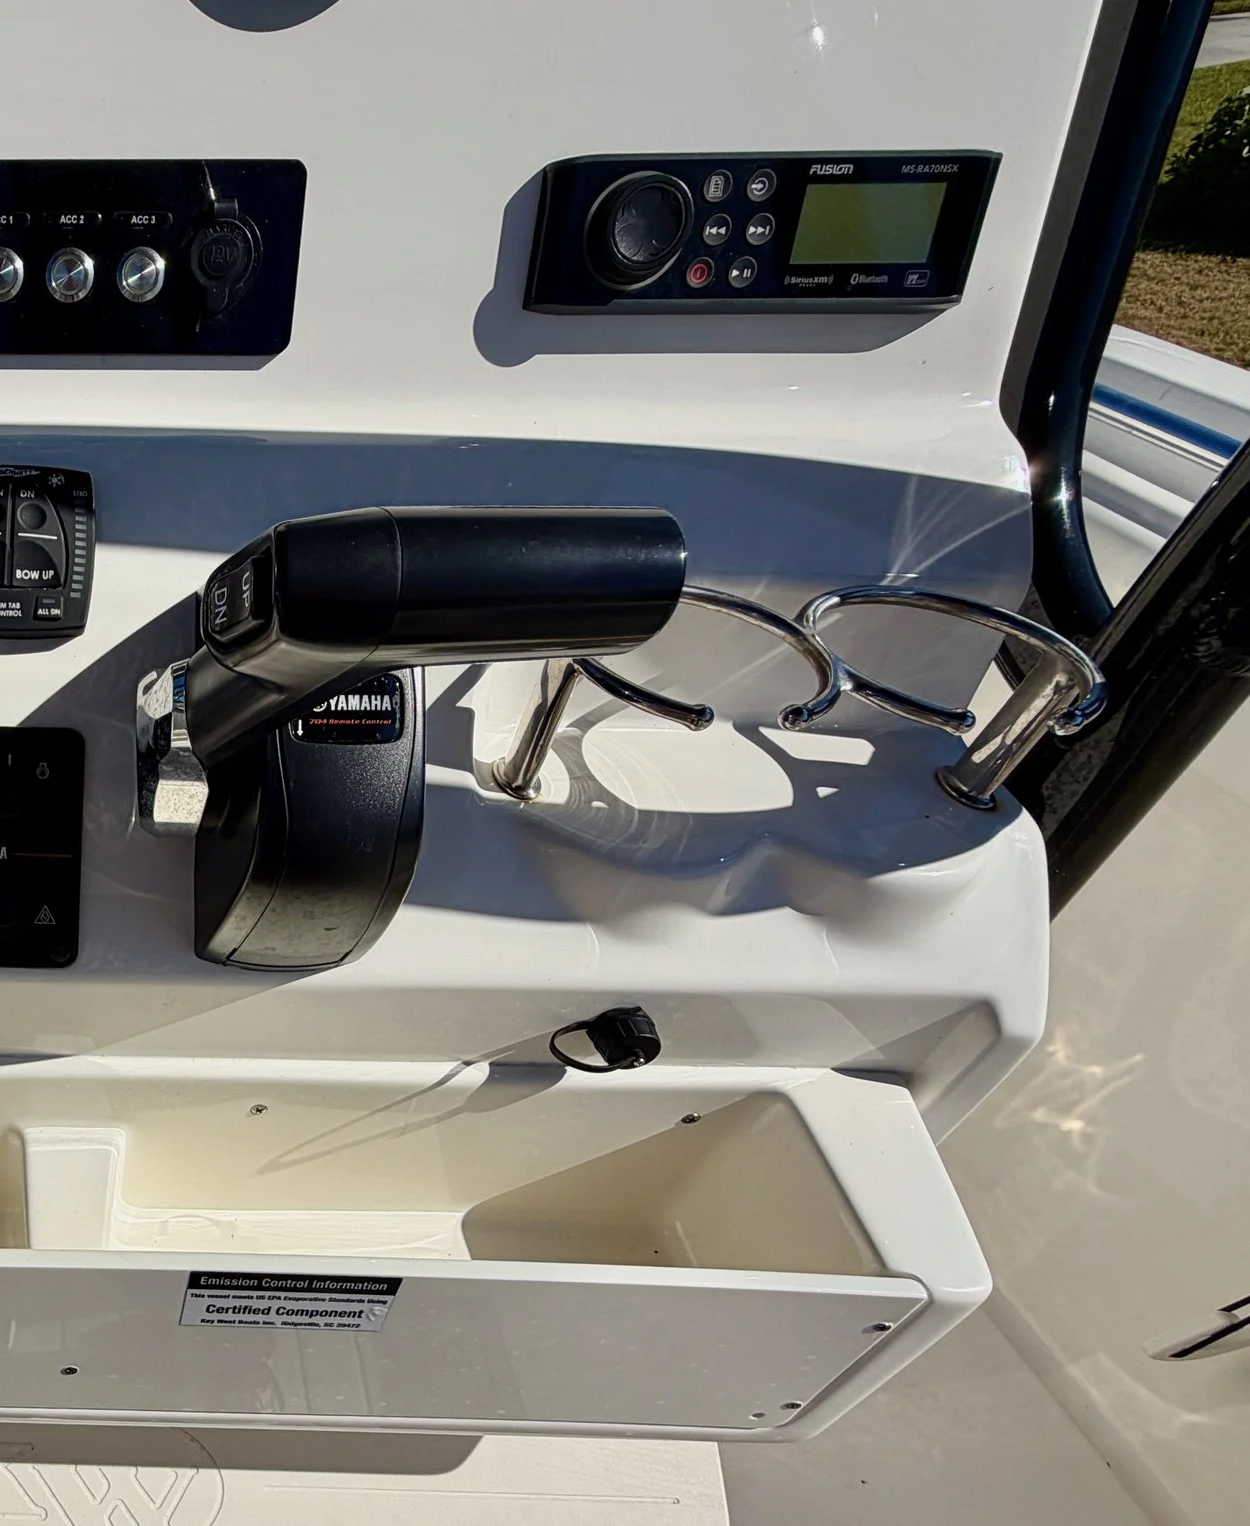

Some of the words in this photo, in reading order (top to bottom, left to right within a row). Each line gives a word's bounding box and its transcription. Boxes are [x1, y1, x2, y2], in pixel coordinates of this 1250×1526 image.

[809, 164, 854, 175] FUSION
[8, 215, 14, 224] 1
[59, 215, 78, 224] ACC
[78, 215, 85, 224] 2
[131, 215, 149, 224] ACC
[150, 215, 156, 224] 3
[20, 490, 35, 498] DN
[16, 569, 41, 580] BOW
[42, 570, 55, 580] UP
[242, 571, 252, 607] UP
[214, 587, 228, 625] DN
[329, 694, 392, 712] YAMAHA
[361, 718, 392, 726] Control
[200, 1276, 258, 1287] Emission
[261, 1278, 309, 1288] Control
[312, 1279, 388, 1291] Information
[205, 1303, 272, 1315] Certified
[275, 1305, 365, 1319] Component
